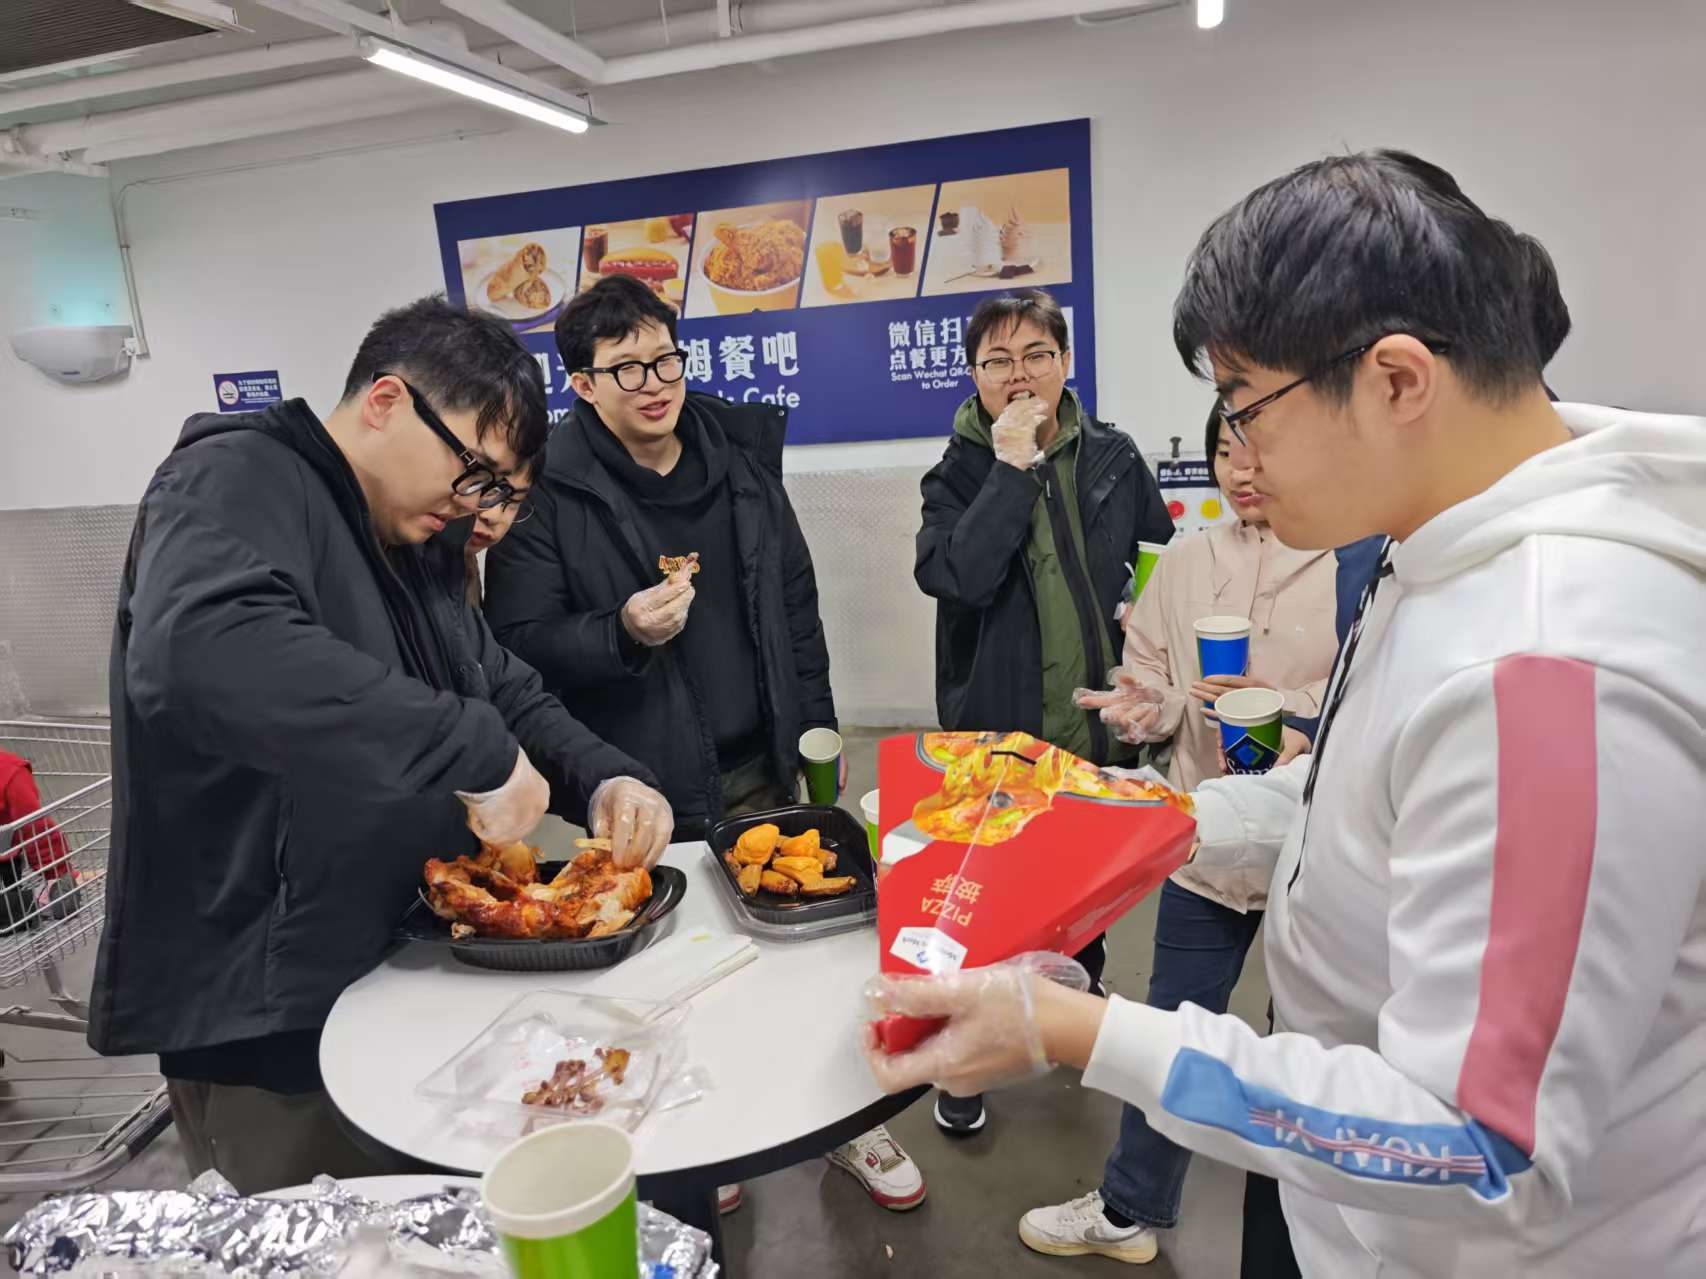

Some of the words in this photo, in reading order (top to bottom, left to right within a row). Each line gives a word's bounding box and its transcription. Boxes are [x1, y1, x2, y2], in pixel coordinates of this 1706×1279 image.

[888, 316, 973, 349] 微信扫
[891, 371, 913, 382] Scan
[914, 368, 948, 379] Wechat
[922, 381, 931, 390] to
[932, 379, 959, 389] Order
[743, 384, 800, 408] Cafe
[930, 873, 983, 904] 披萨
[921, 897, 972, 927] PIZZA
